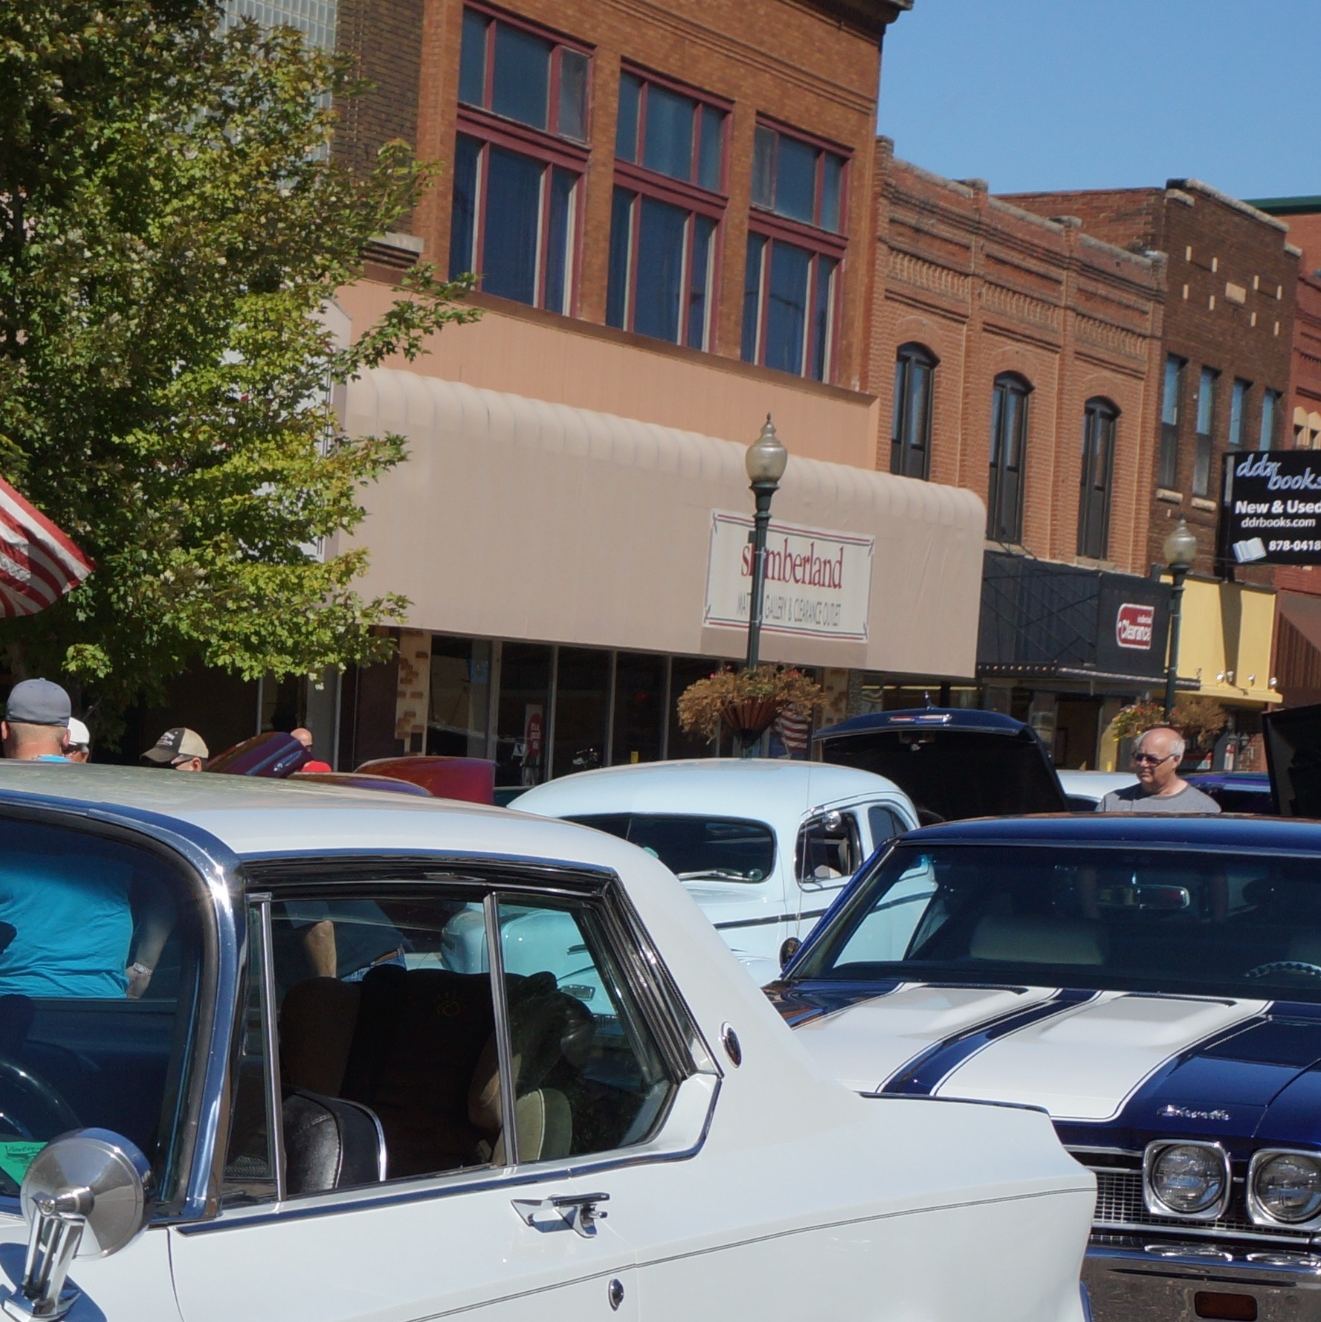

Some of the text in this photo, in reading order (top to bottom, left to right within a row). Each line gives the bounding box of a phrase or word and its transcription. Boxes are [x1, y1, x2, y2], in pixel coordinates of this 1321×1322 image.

[1236, 453, 1282, 477] ddr
[1235, 500, 1269, 514] New
[1271, 500, 1284, 513] &
[1241, 517, 1316, 528] ddrbooks.com
[1268, 540, 1321, 551] 878-0418
[740, 537, 844, 589] slmberland
